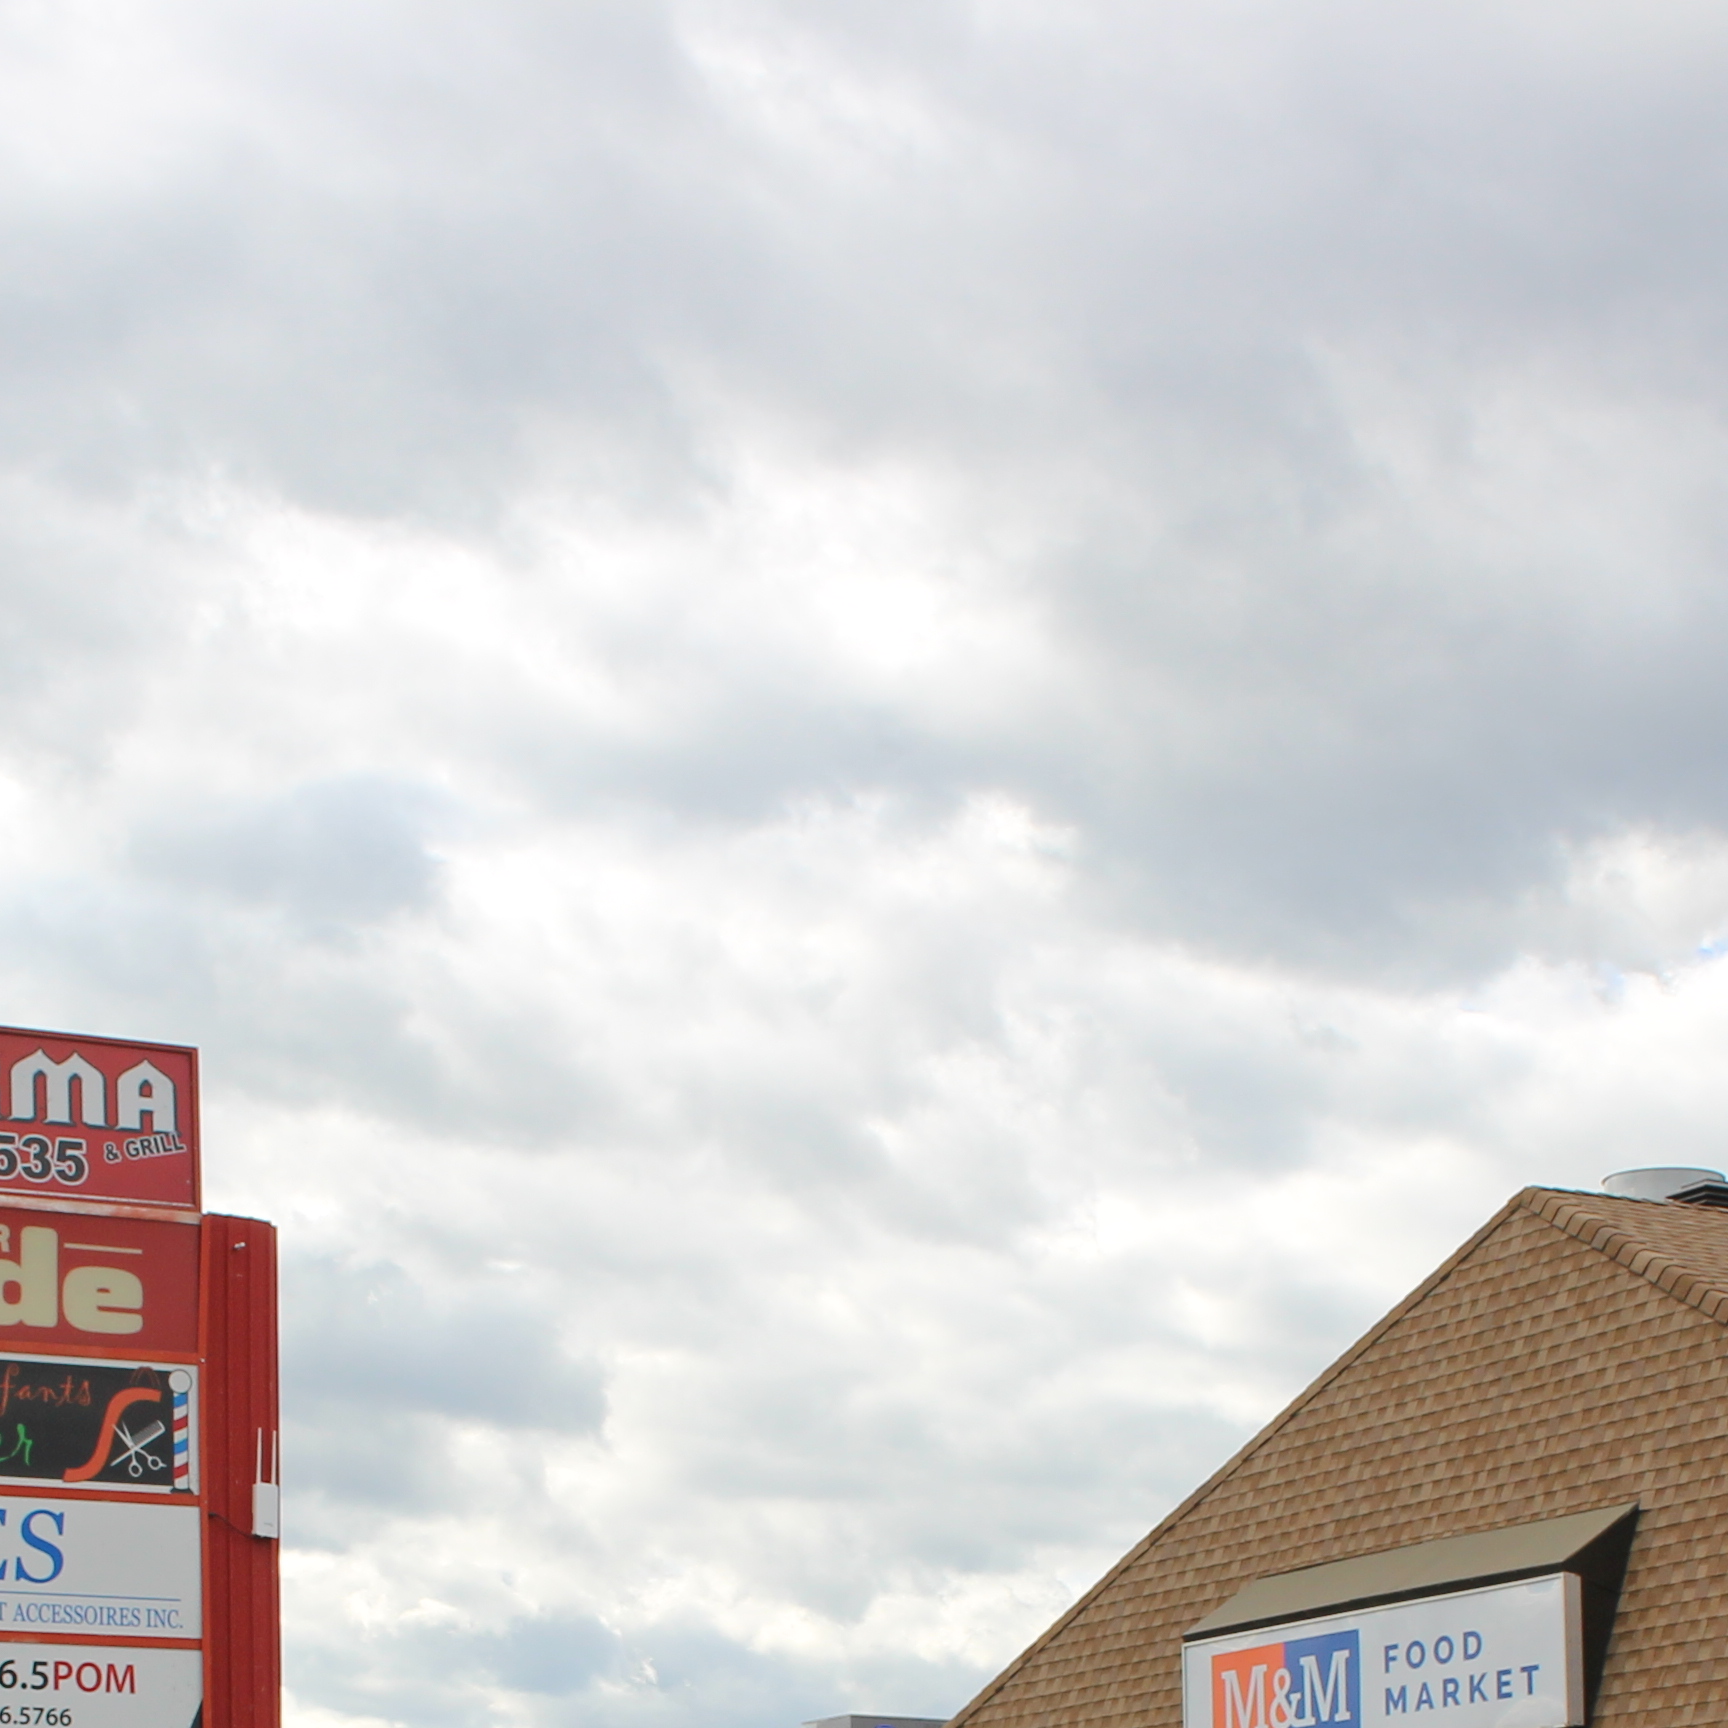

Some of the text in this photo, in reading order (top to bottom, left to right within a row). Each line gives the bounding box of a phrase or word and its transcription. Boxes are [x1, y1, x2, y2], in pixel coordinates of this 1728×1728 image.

[103, 1132, 187, 1164] & GRILL
[12, 1598, 144, 1628] ACCESSOIRES
[145, 1604, 185, 1630] INC.
[1383, 1629, 1484, 1675] FOOD
[1384, 1663, 1541, 1717] MARKET
